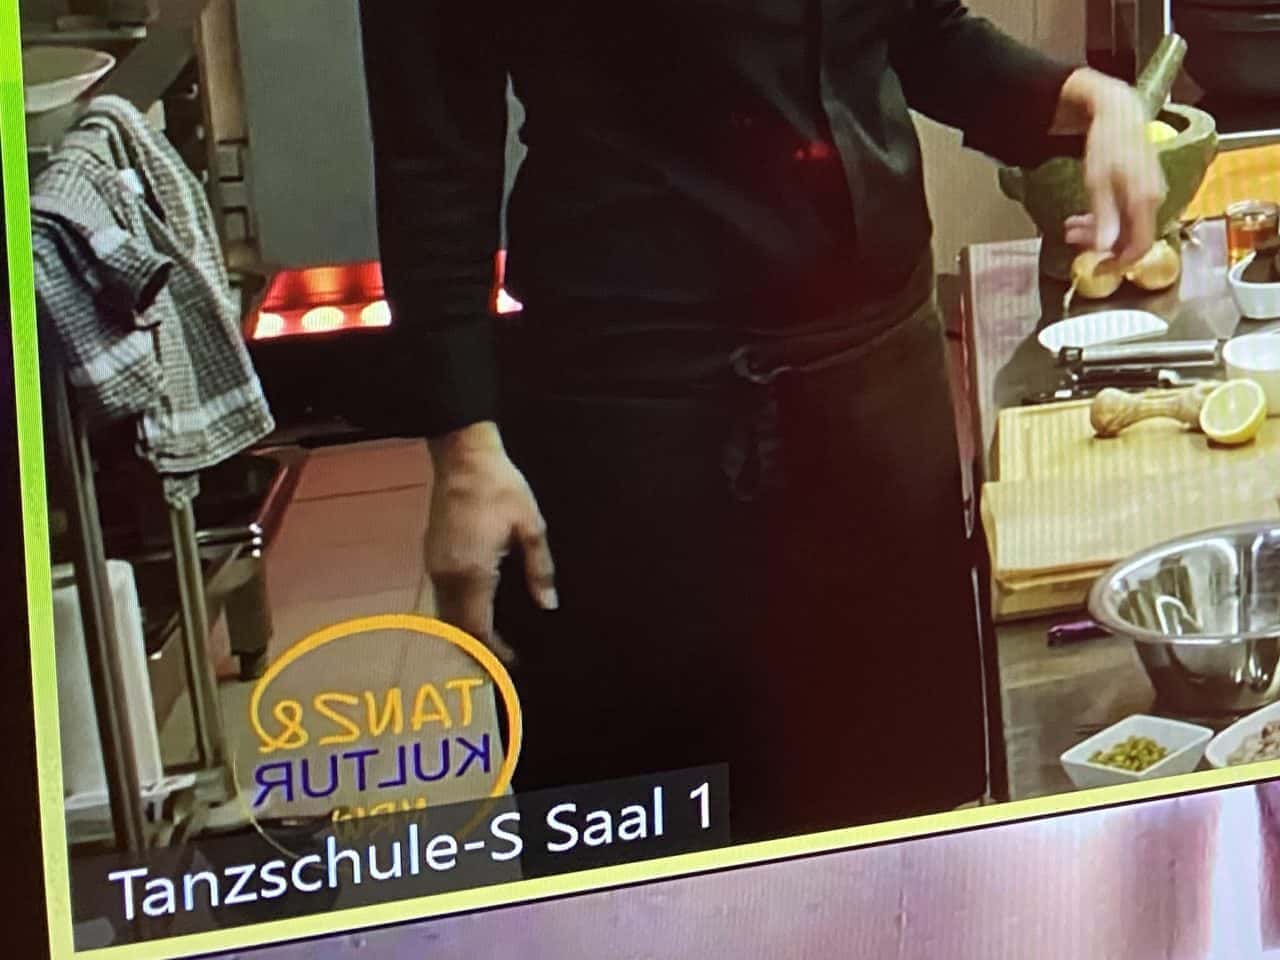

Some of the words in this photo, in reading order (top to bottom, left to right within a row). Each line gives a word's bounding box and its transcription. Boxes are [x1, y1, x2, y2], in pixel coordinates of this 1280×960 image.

[108, 811, 524, 921] Tanzschule-S
[545, 785, 664, 854] Saal
[688, 781, 713, 829] 1
